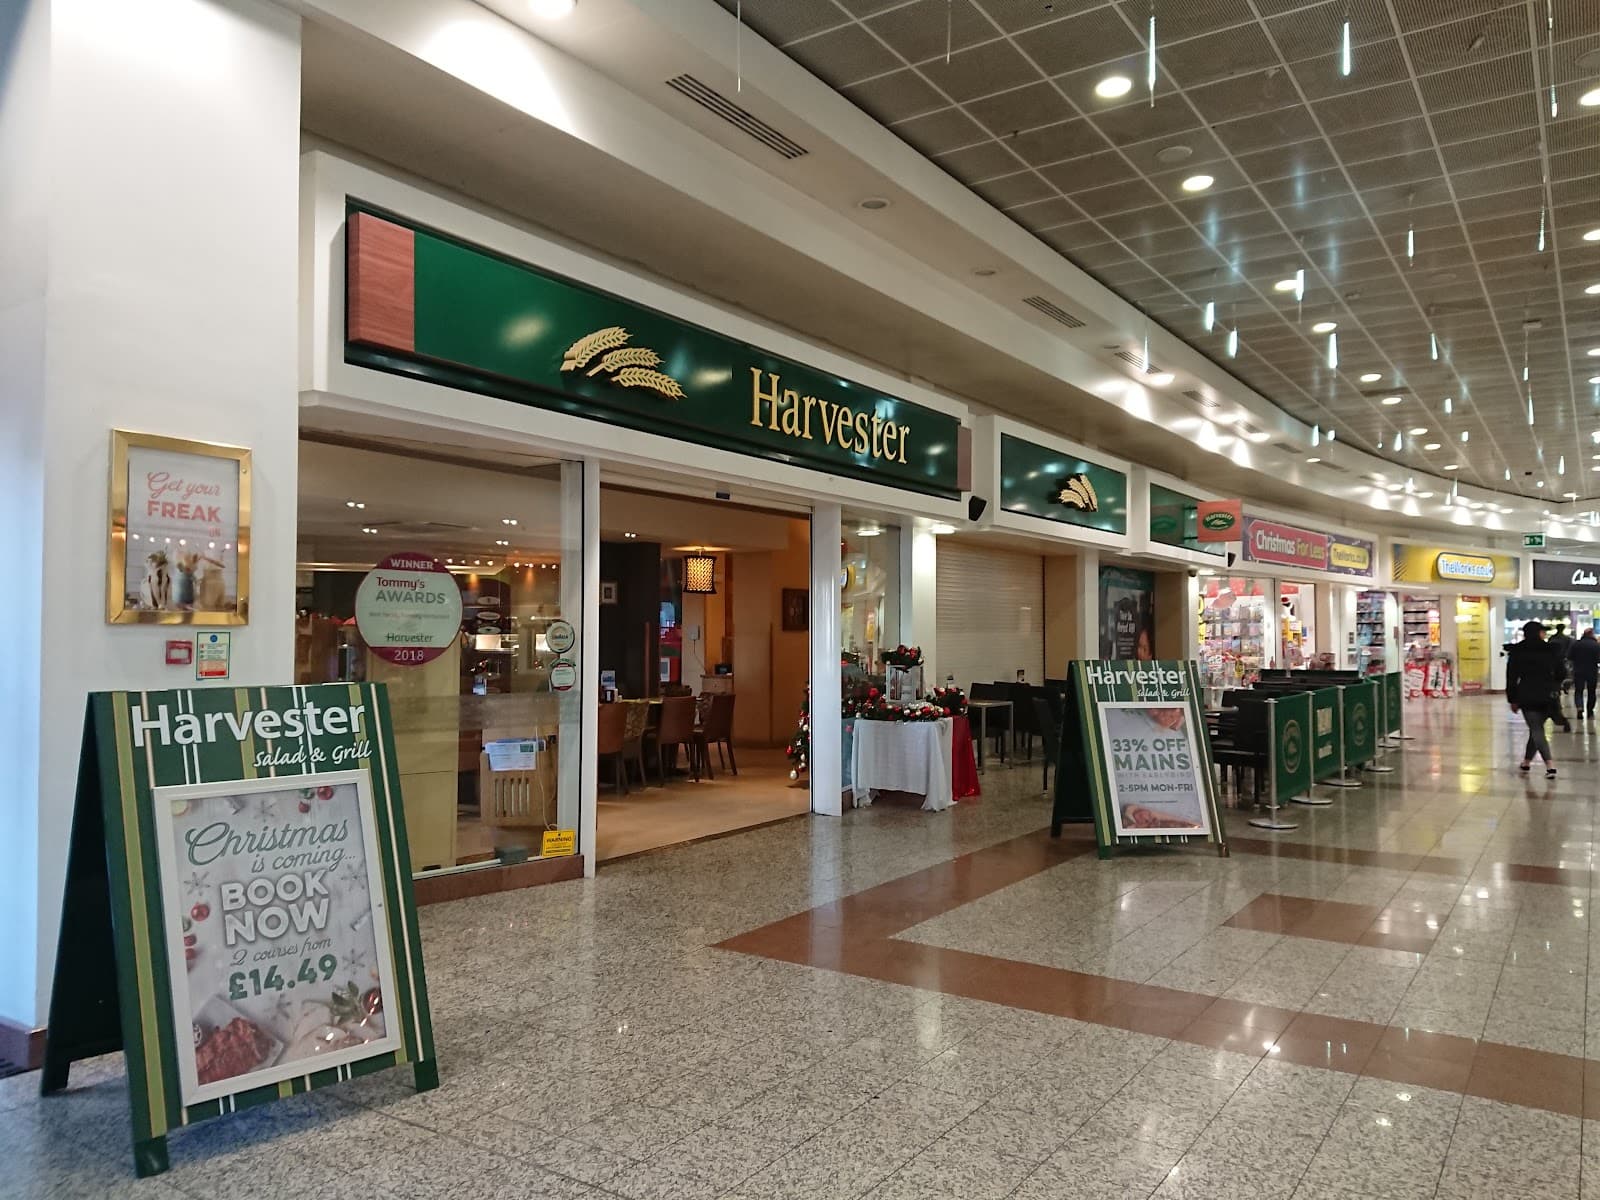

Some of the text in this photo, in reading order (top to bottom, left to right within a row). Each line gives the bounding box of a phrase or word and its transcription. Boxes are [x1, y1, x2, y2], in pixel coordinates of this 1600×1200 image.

[750, 366, 911, 464] Harvester
[147, 471, 220, 500] Get your
[147, 501, 222, 522] FREAK
[1205, 513, 1234, 522] Harvester
[1256, 530, 1296, 555] Christmas
[1296, 538, 1309, 555] For
[390, 559, 434, 570] WINNER
[376, 576, 425, 591] Tommy's
[375, 590, 446, 605] AWARDS
[385, 632, 434, 643] Harvester
[394, 649, 424, 661] 2018
[1086, 666, 1187, 685] Harvester
[1137, 688, 1160, 698] Salad
[1171, 687, 1191, 698] Grill
[131, 701, 365, 747] Harvester
[253, 740, 373, 767] Salad & Grill
[1112, 738, 1187, 752] 33% OFF
[1114, 753, 1191, 771] MAINS
[1119, 783, 1194, 793] 2-5PM MON-FRI
[185, 818, 349, 866] Christmas
[251, 845, 356, 873] is coming...
[219, 868, 330, 911] BOOK
[223, 897, 330, 946] NOW
[230, 936, 333, 966] 2 courses from
[229, 953, 338, 1000] £14.49
